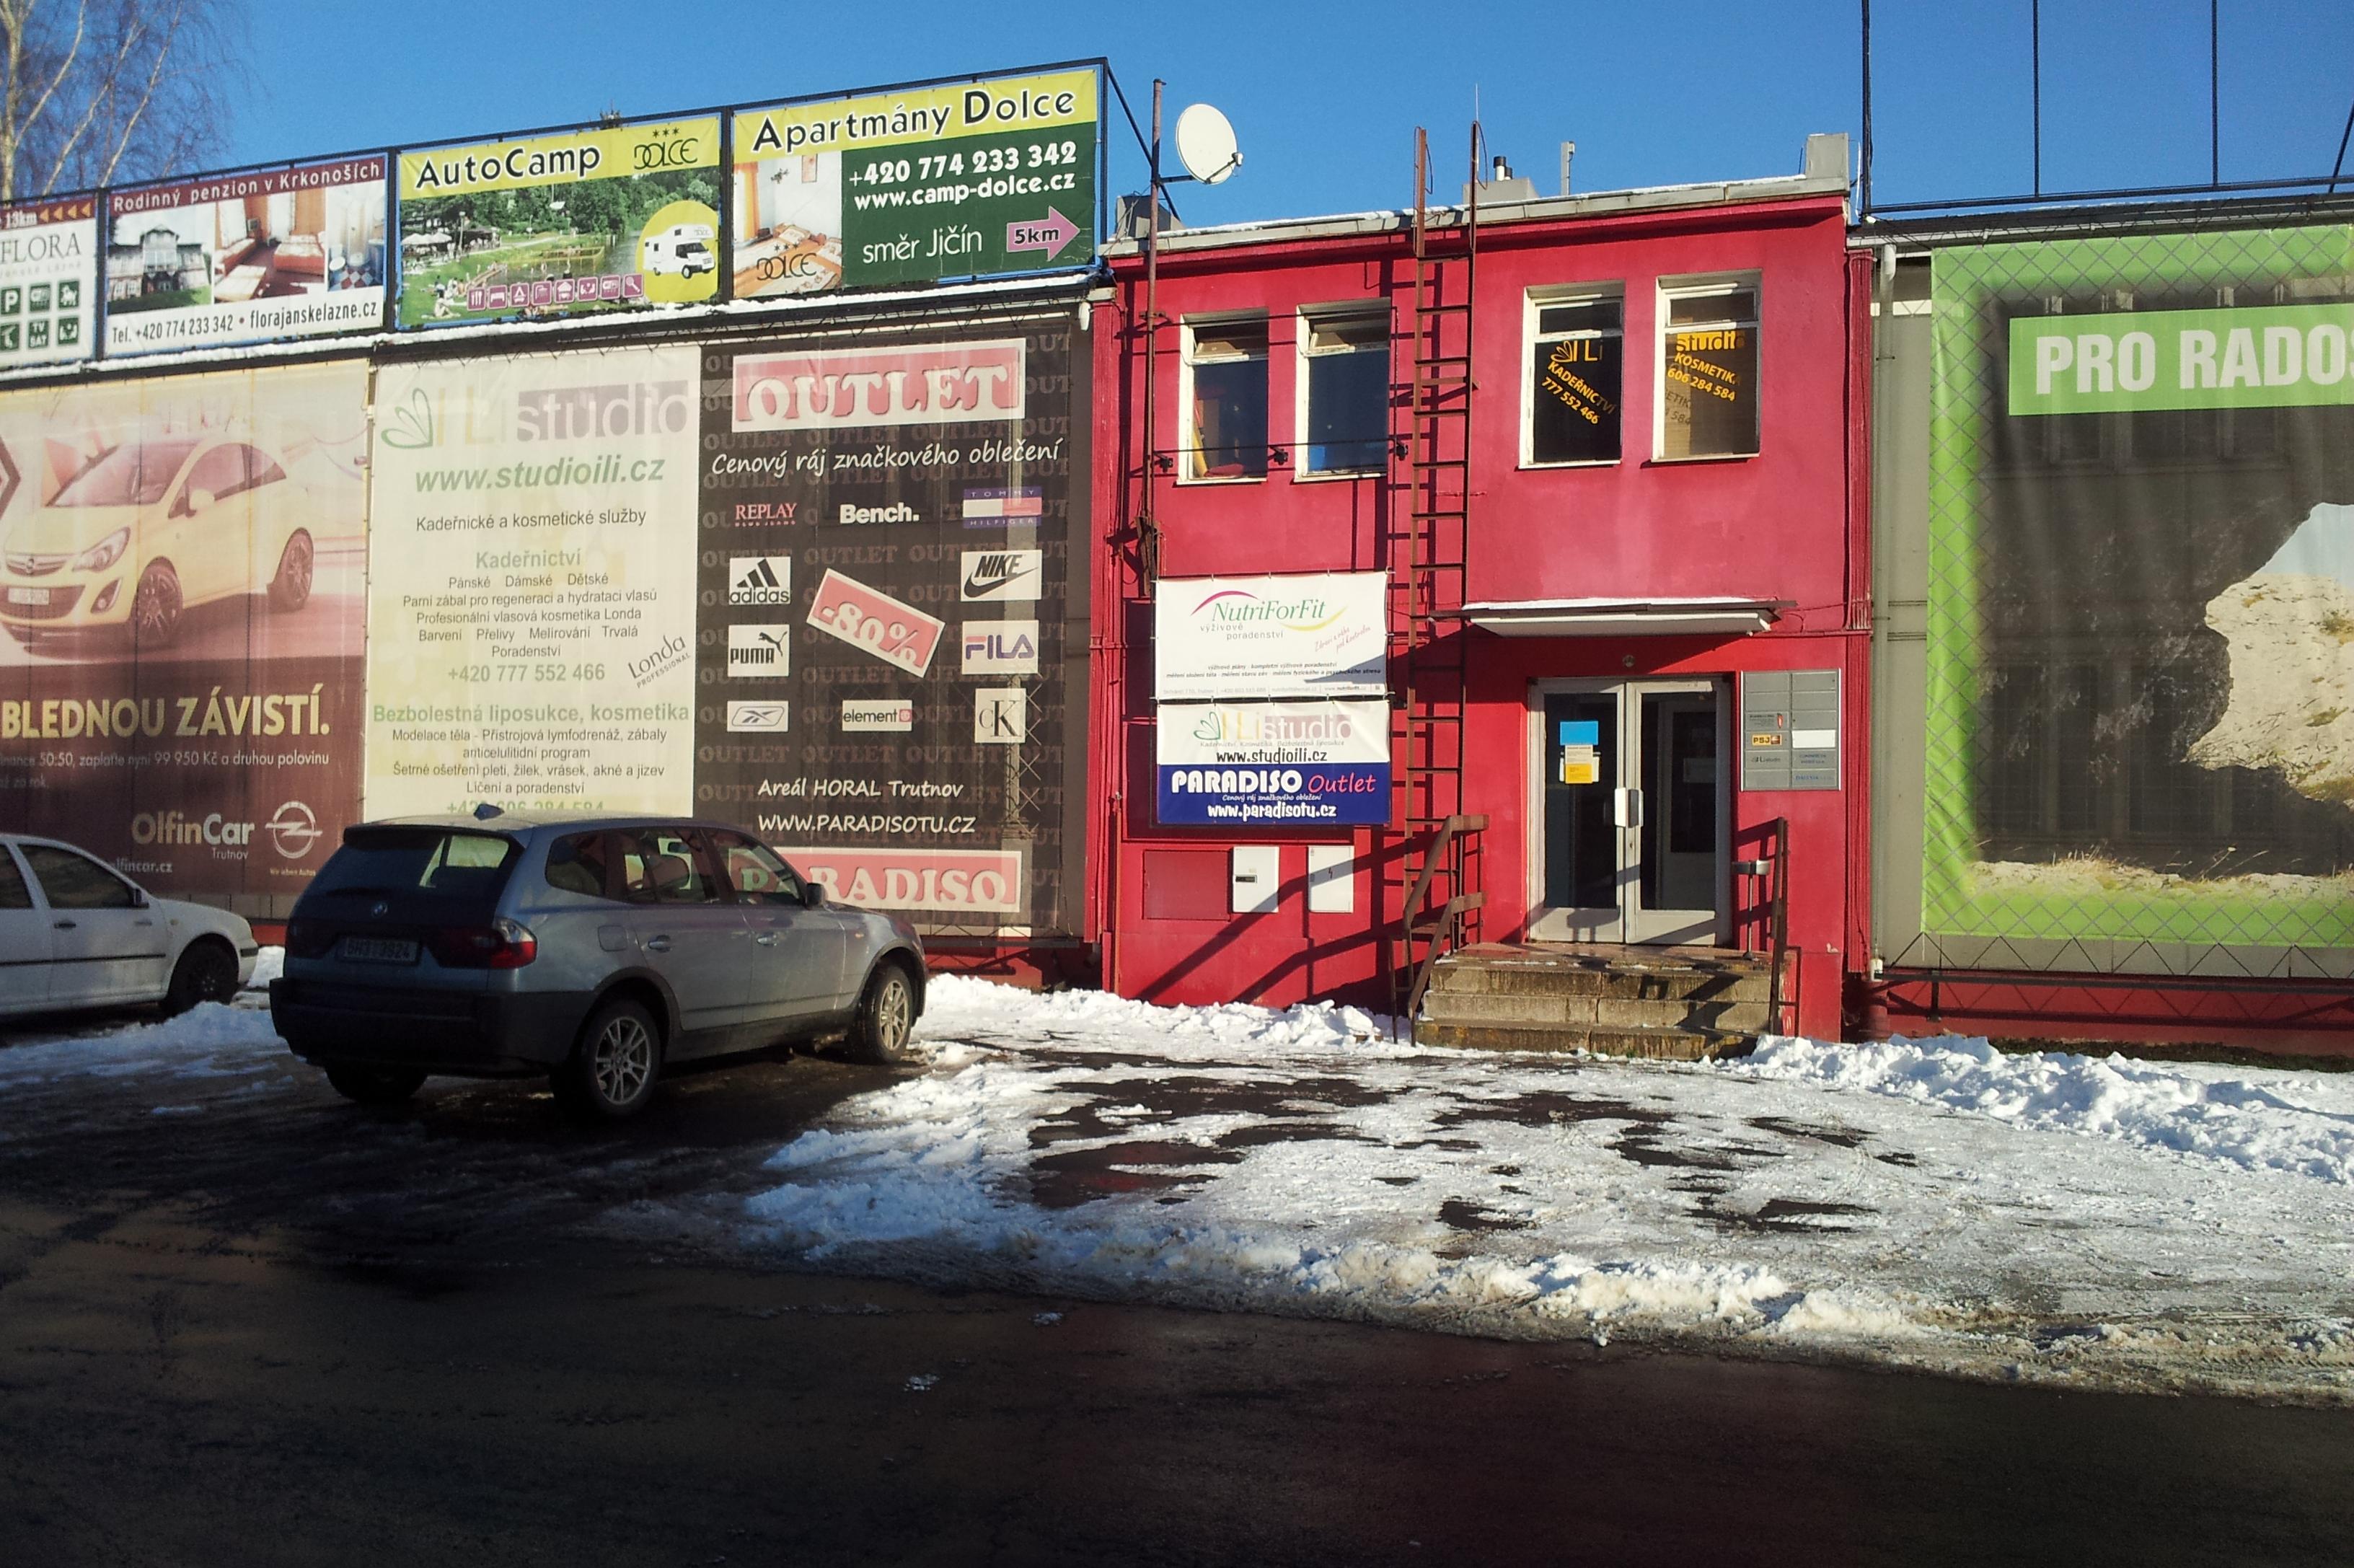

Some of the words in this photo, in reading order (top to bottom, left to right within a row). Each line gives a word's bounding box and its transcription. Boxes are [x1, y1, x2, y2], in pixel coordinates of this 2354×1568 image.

[752, 104, 951, 152] Apartmány
[964, 90, 1075, 124] Dolce
[634, 138, 698, 169] DOLCE
[850, 160, 910, 188] +420
[918, 154, 965, 180] 774
[973, 148, 1020, 174] 233
[1028, 141, 1077, 167] 342
[415, 146, 601, 190] AutoCamp
[113, 190, 180, 213] Rodinný
[191, 180, 257, 203] penzion
[265, 179, 273, 192] v
[280, 162, 379, 190] Krkonoších
[855, 171, 1076, 211] www.camp-dolce.cz
[863, 232, 920, 265] směr
[926, 224, 982, 257] Jičín
[1013, 226, 1059, 245] 5km
[1, 232, 81, 264] FLORA
[756, 252, 817, 281] DOLCE
[113, 326, 131, 343] Tel.
[136, 321, 163, 340] +420
[166, 318, 185, 336] 774
[189, 317, 209, 335] 233
[213, 314, 233, 332] 342
[250, 300, 377, 329] florajanskelazne.cz
[2036, 331, 2156, 395] PRO
[2179, 324, 2354, 389] RADO
[747, 365, 1008, 420] OUTLET
[1667, 369, 1690, 383] 606
[1690, 376, 1713, 392] 284
[1714, 385, 1735, 401] 584
[517, 380, 689, 441] studio
[1542, 376, 1563, 395] 777
[1560, 392, 1581, 410] 552
[1580, 406, 1598, 424] 466
[712, 449, 788, 478] Cenový
[796, 446, 826, 476] ráj
[834, 439, 960, 471] značkového
[969, 436, 1064, 463] oblečení
[415, 454, 666, 493] www.studioili.cz
[416, 513, 494, 532] Kadeřnické
[499, 518, 508, 527] a
[513, 509, 594, 528] kosmetické
[599, 507, 647, 527] služby
[736, 503, 797, 519] REPLAY
[839, 502, 920, 524] Bench.
[476, 547, 581, 568] Kadeřnictví
[975, 554, 1022, 577] NIKE
[449, 576, 491, 589] Pánské
[505, 574, 553, 587] Dámské
[568, 572, 609, 586] Dětské
[403, 594, 432, 607] Parní
[436, 593, 467, 607] zábal
[470, 596, 488, 609] pro
[492, 592, 553, 607] regeneraci
[557, 595, 564, 604] a
[568, 591, 622, 607] hydrataci
[626, 589, 658, 602] vlasů
[729, 588, 790, 604] adidas
[416, 609, 490, 625] Profesionální
[493, 609, 537, 622] vlasová
[541, 609, 600, 622] kosmetika
[604, 607, 642, 620] Londa
[1212, 599, 1326, 622] NutriForFit
[418, 628, 462, 642] Barvení
[477, 627, 515, 643] Přelivy
[529, 625, 591, 640] Melírování
[601, 625, 638, 638] Trvalá
[1200, 623, 1243, 633] výživové
[1227, 630, 1283, 640] poradenství
[492, 644, 561, 658] Poradenství
[627, 635, 687, 679] Londa
[966, 634, 1034, 659] FILA
[449, 665, 490, 682] +420
[497, 665, 528, 682] 777
[534, 664, 566, 681] 552
[573, 664, 605, 680] 466
[636, 652, 691, 689] PROFESSIONAL
[1, 698, 165, 739] BLEDNOU
[175, 683, 330, 737] ZÁVISTÍ.
[374, 704, 482, 722] Bezbolestná
[490, 703, 584, 726] liposukce,
[591, 703, 689, 721] kosmetika
[843, 709, 897, 723] element
[392, 728, 446, 741] Modelace
[450, 728, 470, 741] těla
[482, 727, 544, 744] Přístrojová
[627, 728, 667, 743] zábaly
[1265, 715, 1352, 739] studio
[154, 752, 171, 765] 99
[175, 752, 199, 766] 950
[221, 755, 229, 765] a
[233, 750, 274, 766] druhou
[278, 749, 330, 769] polovinu
[541, 749, 591, 762] program
[1217, 747, 1327, 764] www.studioili.cz
[393, 762, 430, 776] Šetrné
[433, 763, 480, 776] ošetření
[593, 763, 622, 776] akné
[626, 767, 633, 776] a
[636, 765, 664, 778] jizev
[1171, 770, 1302, 793] PARADISO
[1308, 772, 1376, 793] Outlet
[467, 780, 501, 794] Líčení
[505, 784, 512, 793] a
[516, 781, 585, 796] poradenství
[757, 778, 806, 797] Areál
[813, 779, 881, 796] HORAL
[889, 780, 964, 798] Trutnov
[1207, 801, 1336, 821] www.paradisotu.cz
[131, 810, 255, 846] OlfinCar
[758, 814, 977, 833] WWW.PARADISOTU.CZ
[211, 848, 249, 860] Trutnov
